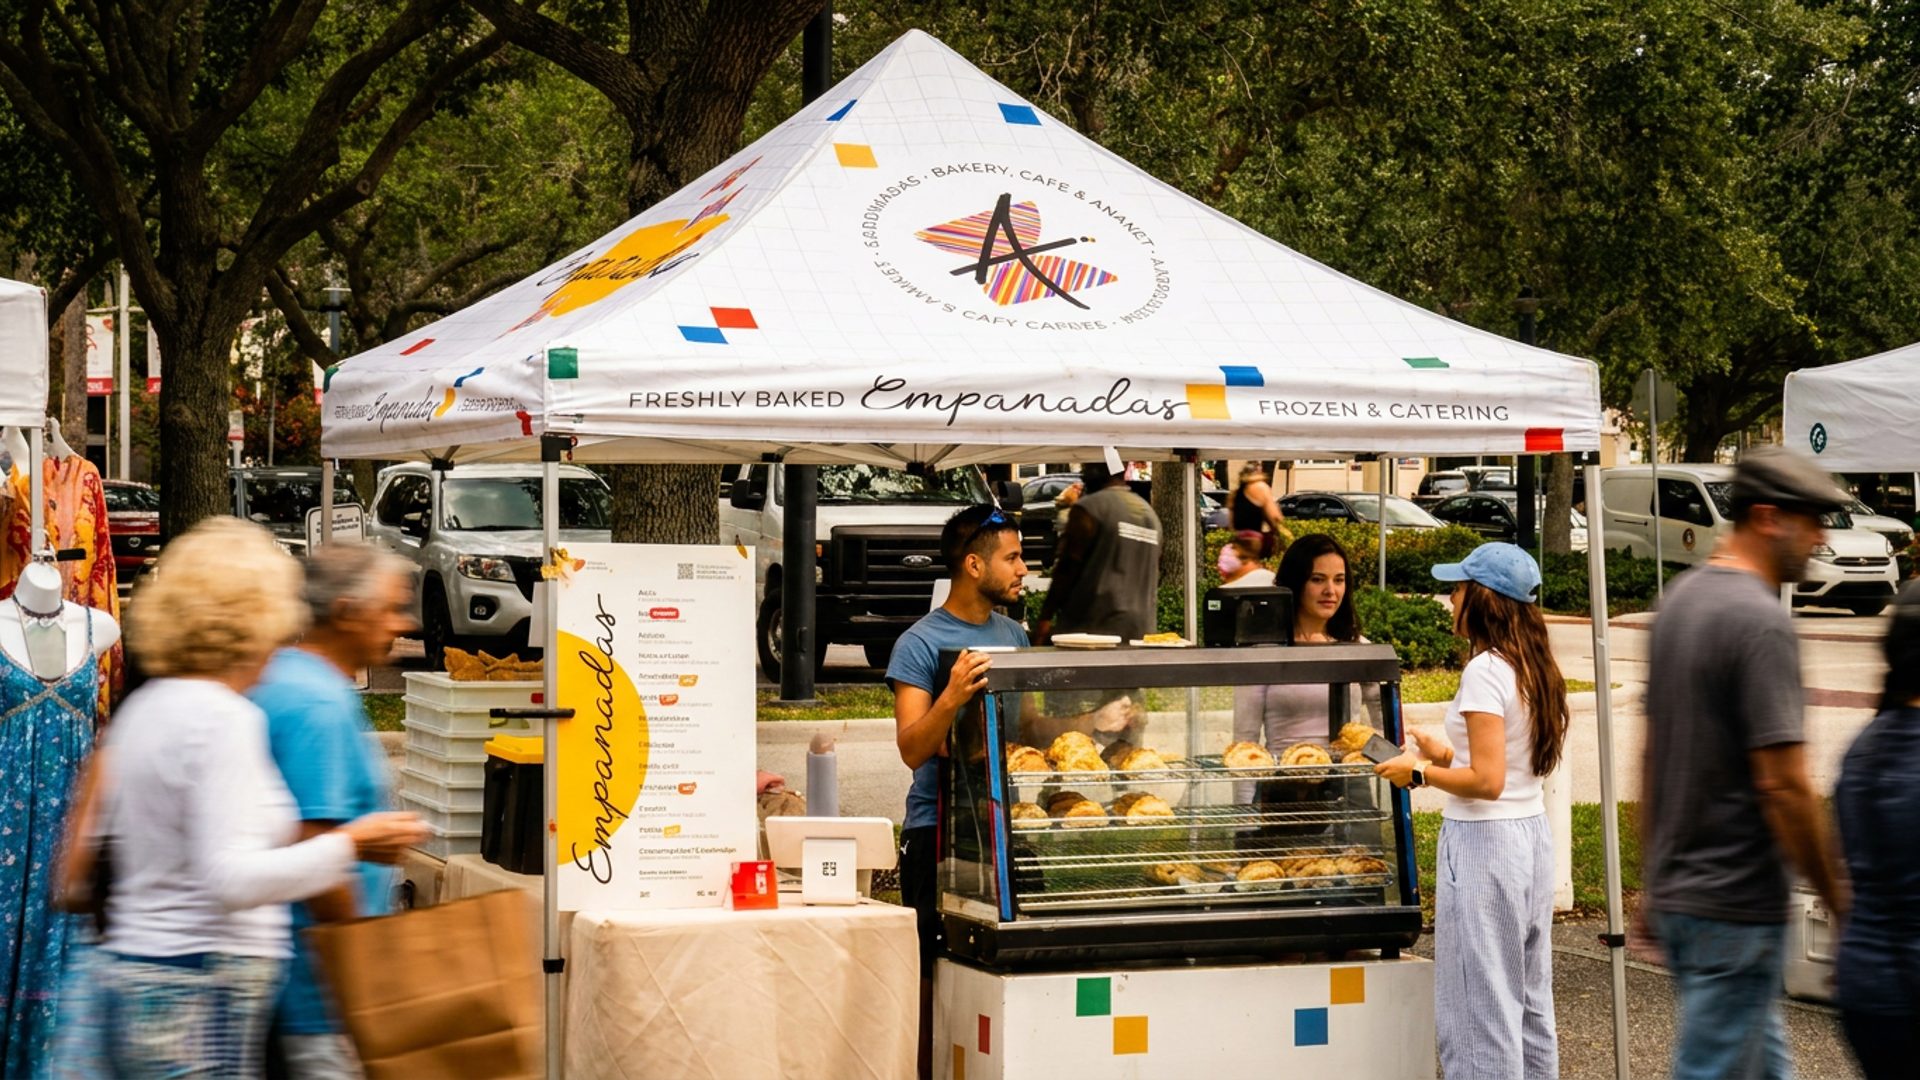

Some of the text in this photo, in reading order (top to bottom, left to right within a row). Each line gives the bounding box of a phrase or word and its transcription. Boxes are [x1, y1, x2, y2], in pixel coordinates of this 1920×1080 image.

[1019, 169, 1070, 192] CAFE
[629, 375, 1190, 427] FRESHLY BAKED Empanadas
[1259, 400, 1510, 421] FROZEN & CATERING
[571, 593, 629, 885] Empanadas
